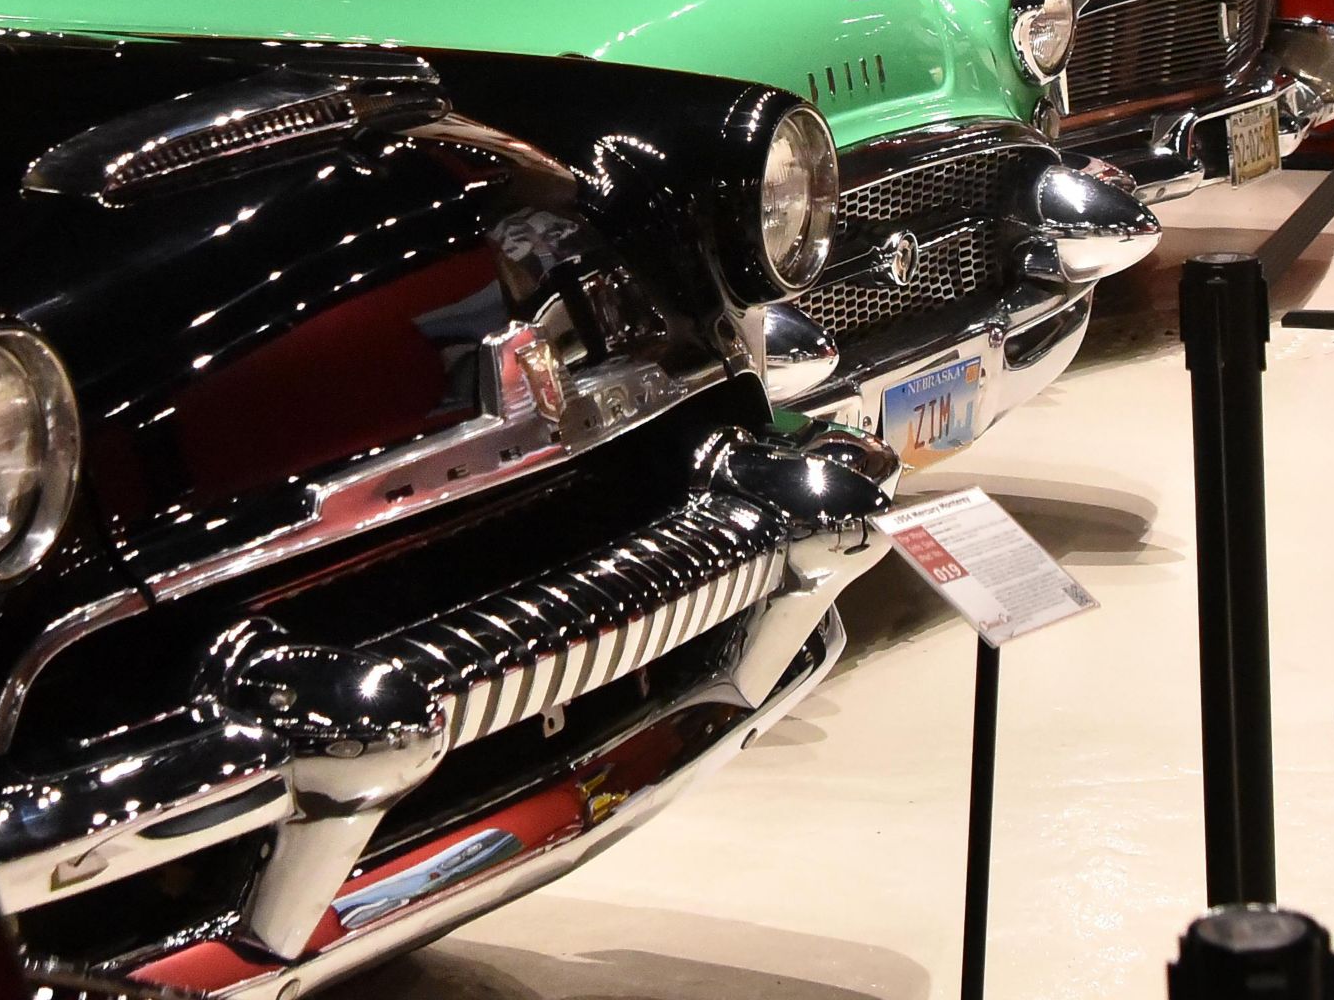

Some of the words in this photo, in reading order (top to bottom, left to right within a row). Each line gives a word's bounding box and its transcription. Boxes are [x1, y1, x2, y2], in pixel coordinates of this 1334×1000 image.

[907, 367, 961, 396] NEBRASKA
[913, 392, 951, 450] ZIM
[932, 562, 963, 583] 019
